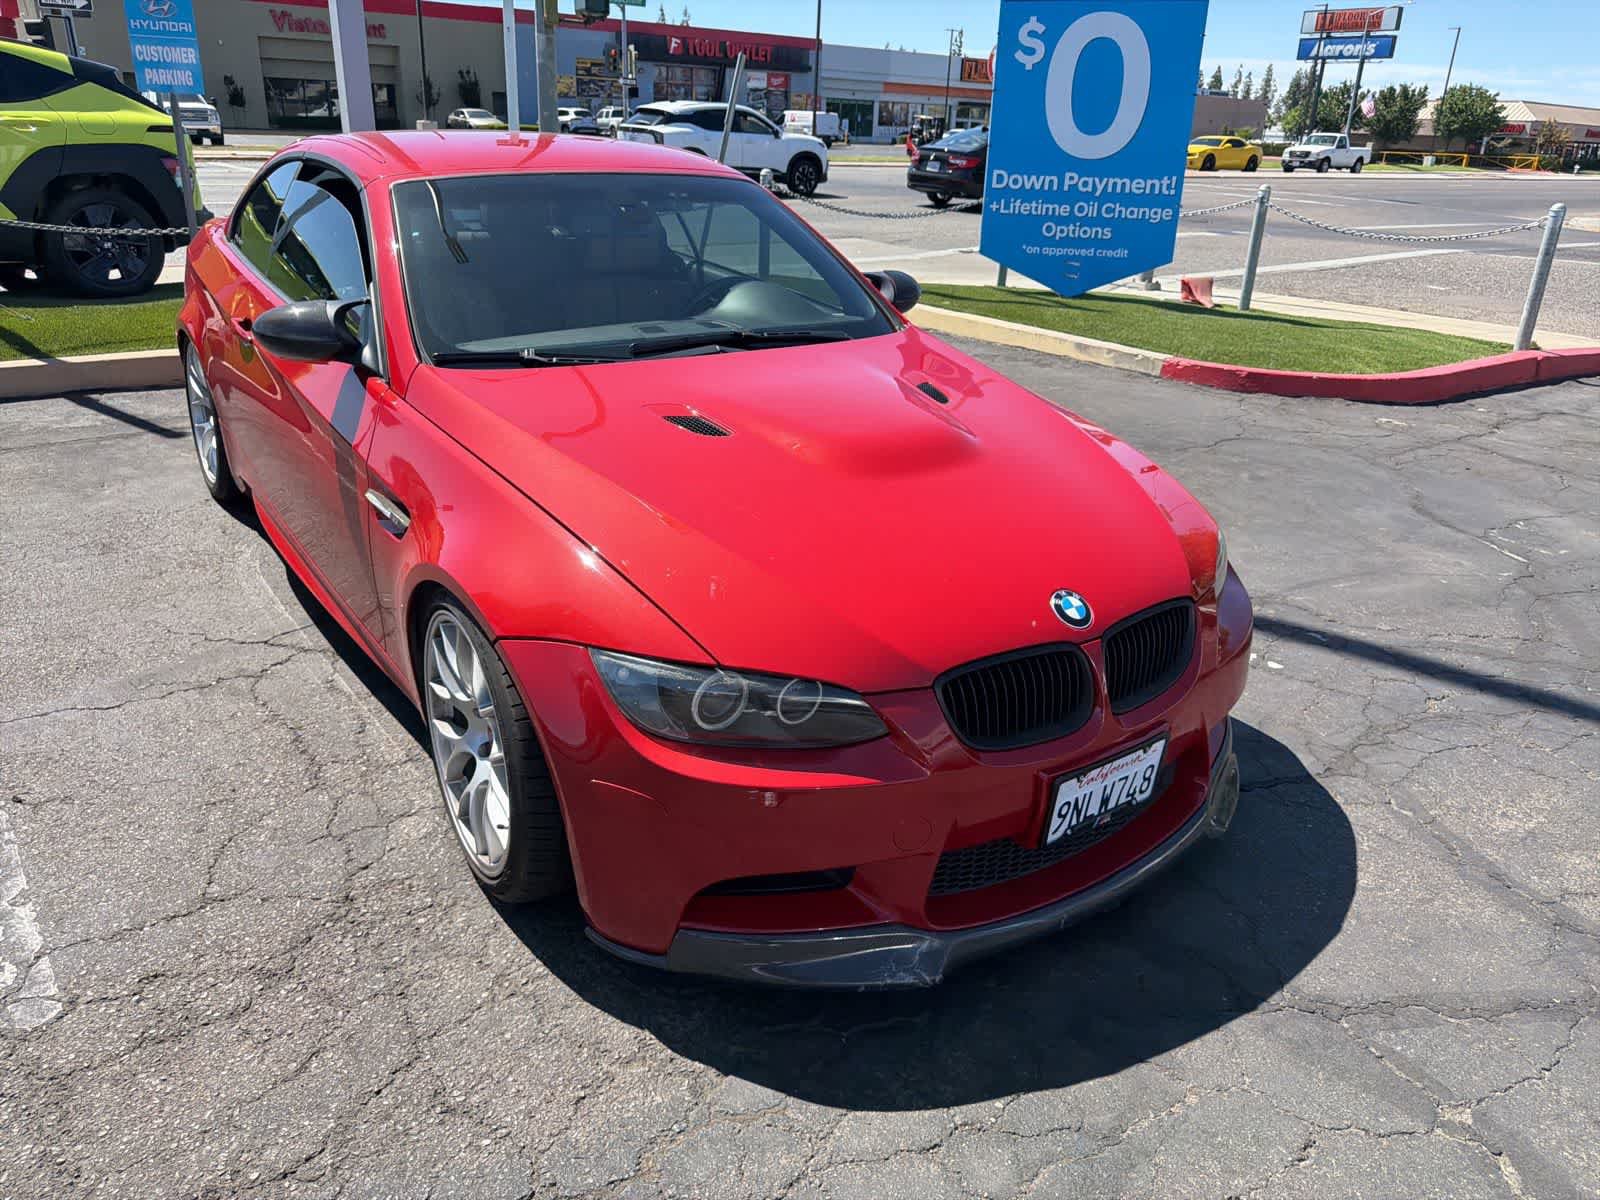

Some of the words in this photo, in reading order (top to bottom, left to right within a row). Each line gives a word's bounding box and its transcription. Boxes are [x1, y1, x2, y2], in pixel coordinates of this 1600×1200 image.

[130, 19, 192, 33] HYUNDAI
[135, 44, 196, 64] CUSTOMER
[688, 38, 723, 57] TOOL
[726, 41, 774, 64] OUTLET
[144, 68, 193, 86] PARKING
[991, 169, 1058, 191] Down
[1063, 172, 1177, 197] Payment!
[989, 199, 1070, 217] +Lifetime
[1074, 202, 1098, 218] Oil
[1101, 203, 1173, 223] Change
[1042, 222, 1112, 240] Options
[1042, 245, 1095, 257] approved
[1096, 247, 1129, 259] credit
[1078, 752, 1146, 788] California
[1051, 765, 1155, 835] 9NLW748
